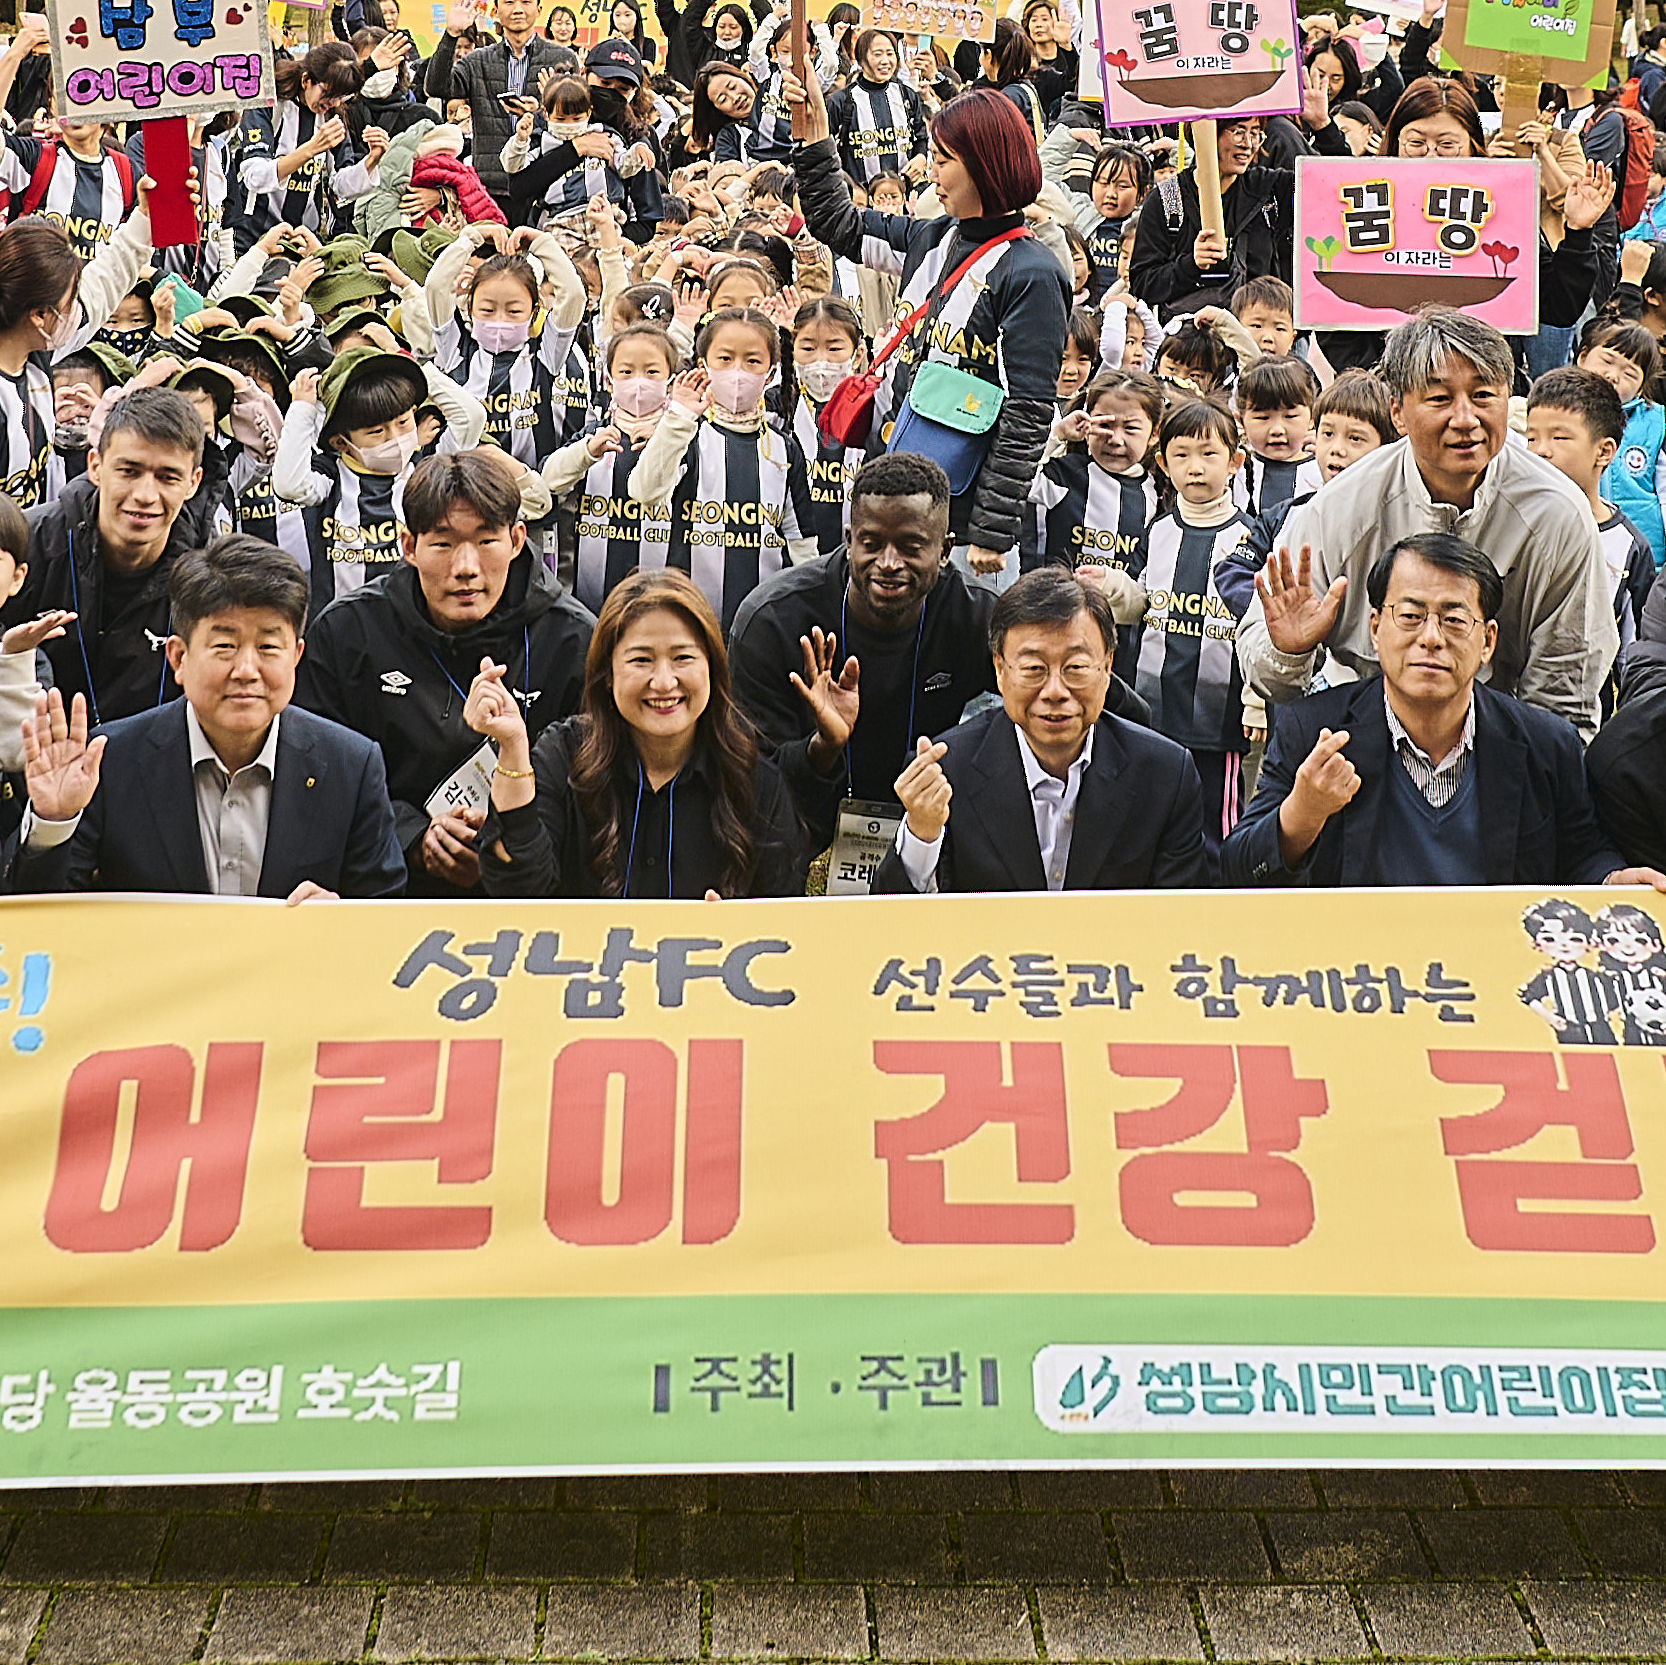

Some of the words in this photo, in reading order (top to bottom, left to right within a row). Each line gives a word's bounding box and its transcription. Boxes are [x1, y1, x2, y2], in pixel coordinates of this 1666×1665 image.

[1132, 2, 1182, 64] 꿈
[1209, 0, 1261, 58] 땅
[1529, 13, 1577, 36] 어린이집
[65, 53, 262, 109] 어린이집
[1192, 55, 1233, 72] 자라는
[1338, 178, 1397, 254] 꿈
[1422, 183, 1496, 257] 땅
[1384, 251, 1401, 269] 이
[1404, 249, 1453, 271] 자라는
[645, 525, 671, 544] CLU
[683, 529, 761, 549] FOOTBALL
[392, 926, 799, 1021] 성남FC
[871, 952, 1145, 1020] 선수들과
[1170, 951, 1477, 1025] 함께하는
[42, 1036, 746, 1255] 어린이
[871, 1038, 1331, 1249] 건강
[64, 1362, 285, 1430] 율동공원
[295, 1359, 464, 1424] 호숫길
[689, 1350, 797, 1415] 주최
